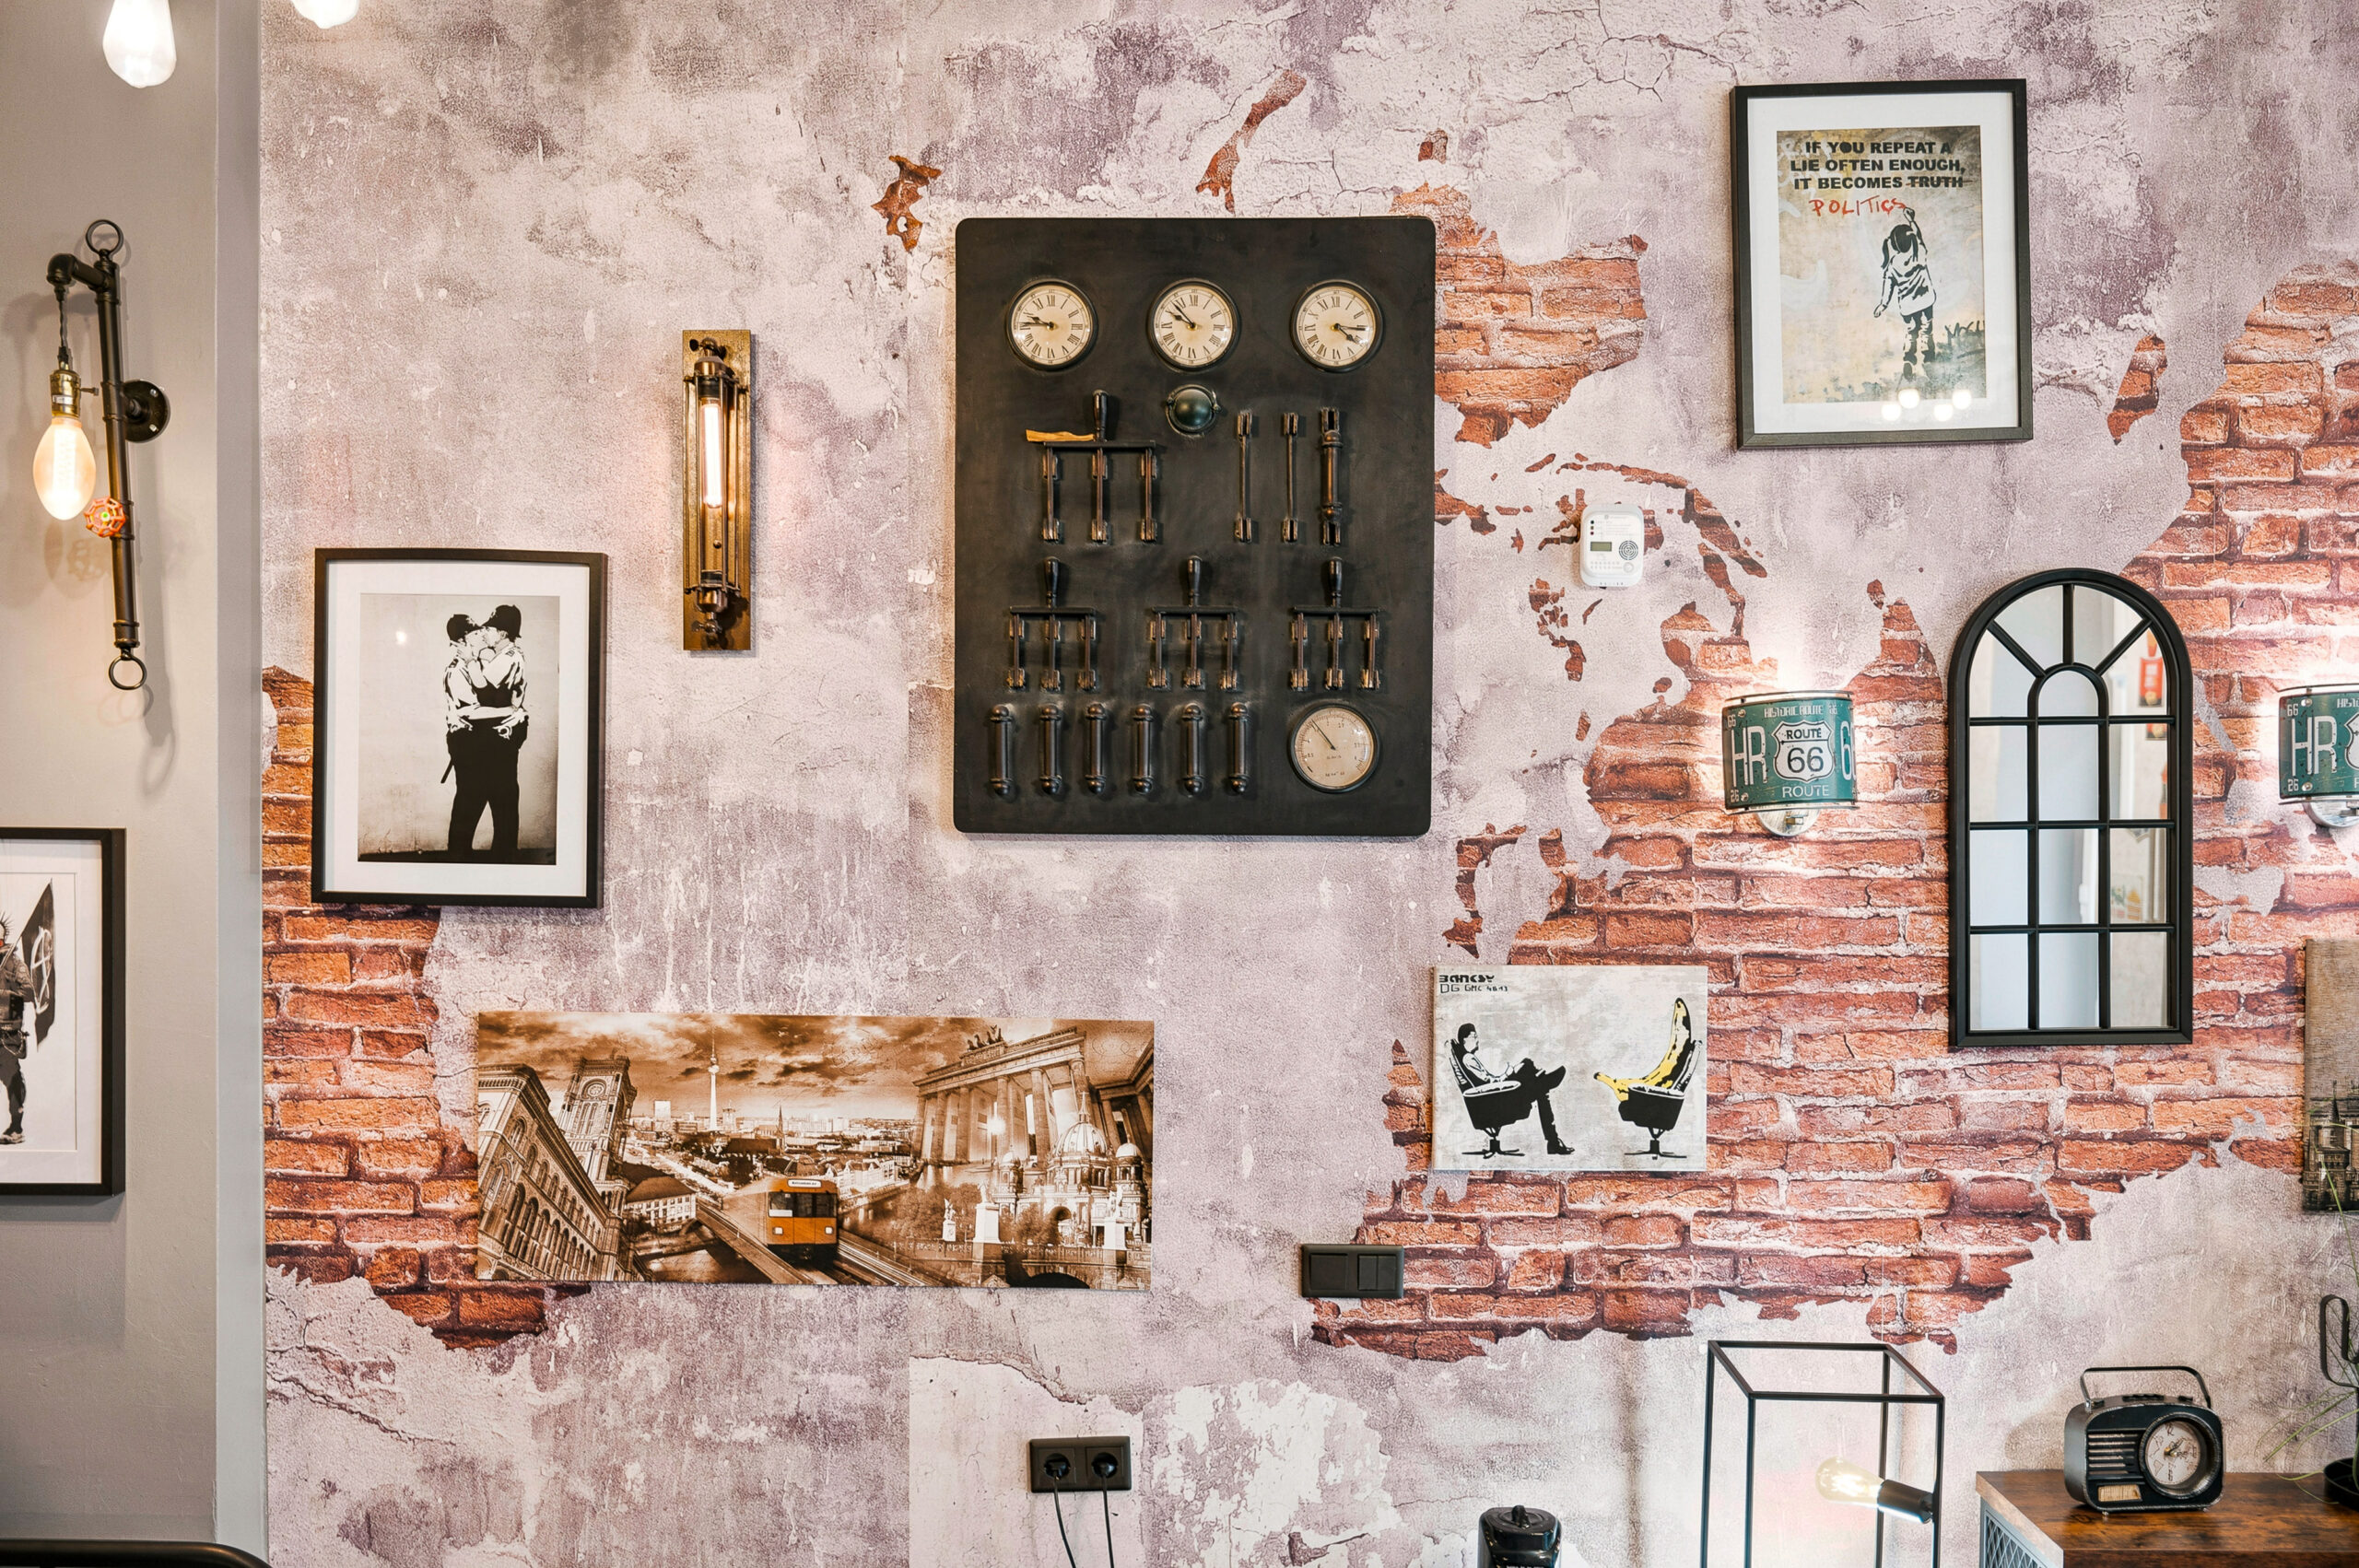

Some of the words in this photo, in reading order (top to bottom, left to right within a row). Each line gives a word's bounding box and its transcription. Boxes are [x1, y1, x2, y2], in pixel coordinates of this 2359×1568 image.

[1805, 142, 1822, 154] IF
[1828, 142, 1865, 154] YOU
[1871, 142, 1936, 154] REPEAT
[1940, 142, 1952, 154] A
[1790, 159, 1820, 171] LIE
[1825, 158, 1884, 171] OFTEN
[1889, 158, 1966, 174] ENOUGH,
[1794, 178, 1812, 190] IT
[1817, 176, 1903, 190] BECOMES
[1907, 176, 1964, 188] TRUTH
[1809, 195, 1907, 216] POLITICS
[1764, 706, 1799, 718] HISTORIC
[1799, 705, 1824, 716] ROUTE
[2287, 703, 2299, 717] 66
[1727, 714, 1737, 728] 66
[1786, 727, 1822, 740] ROUTE
[1840, 720, 1857, 780] 6
[2292, 715, 2338, 777] HR
[1731, 725, 1768, 788] HR
[1787, 746, 1824, 773] 66
[1782, 785, 1830, 798] ROUTE
[2287, 778, 2299, 792] 26
[1730, 790, 1740, 802] 26
